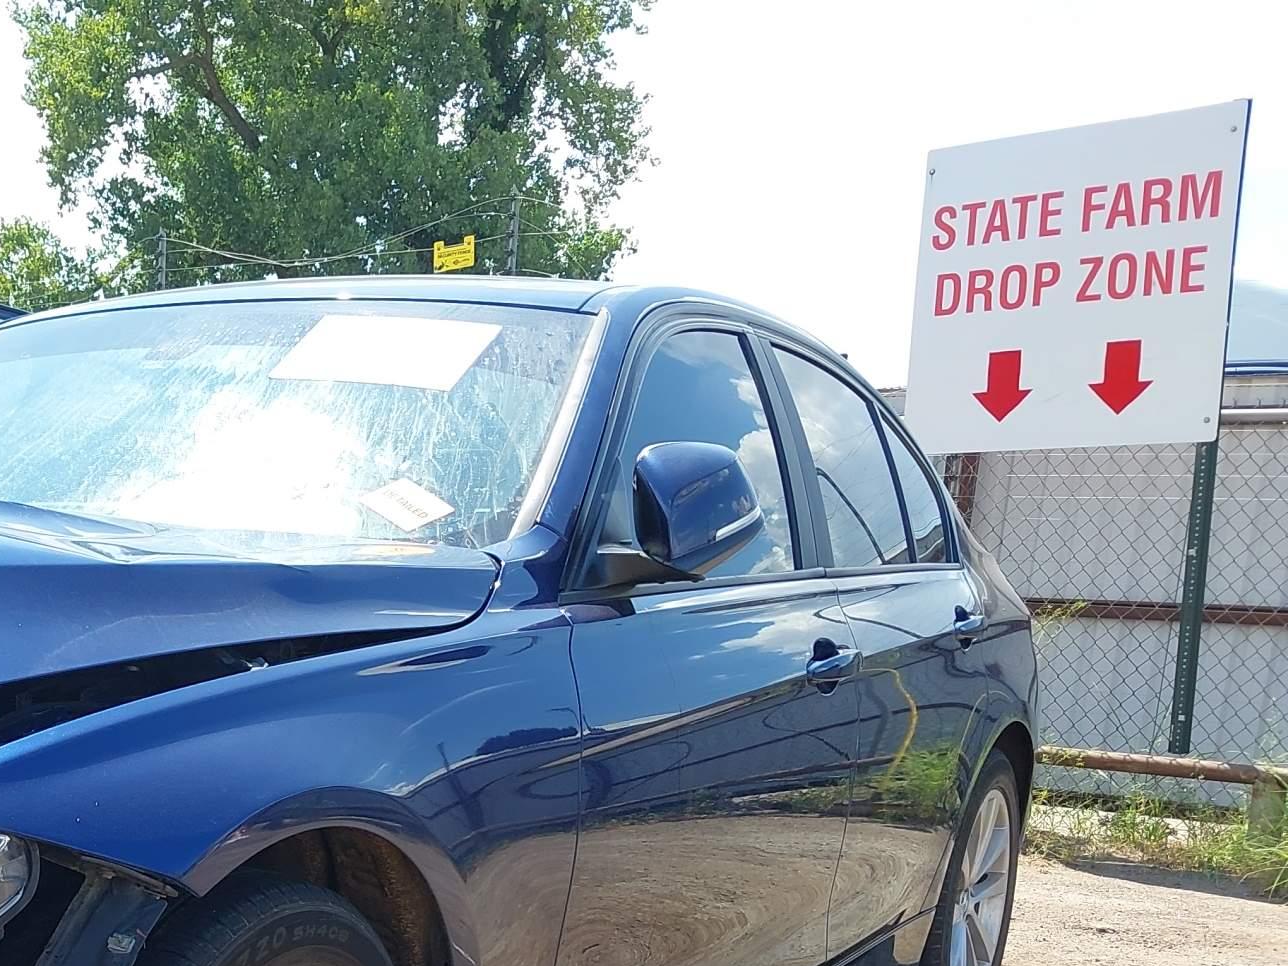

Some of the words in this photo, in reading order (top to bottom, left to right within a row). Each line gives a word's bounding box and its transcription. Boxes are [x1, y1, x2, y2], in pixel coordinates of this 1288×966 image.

[931, 191, 1064, 251] STATE
[1080, 170, 1223, 232] FARM
[934, 262, 1062, 317] DROP
[1075, 246, 1208, 302] ZONE
